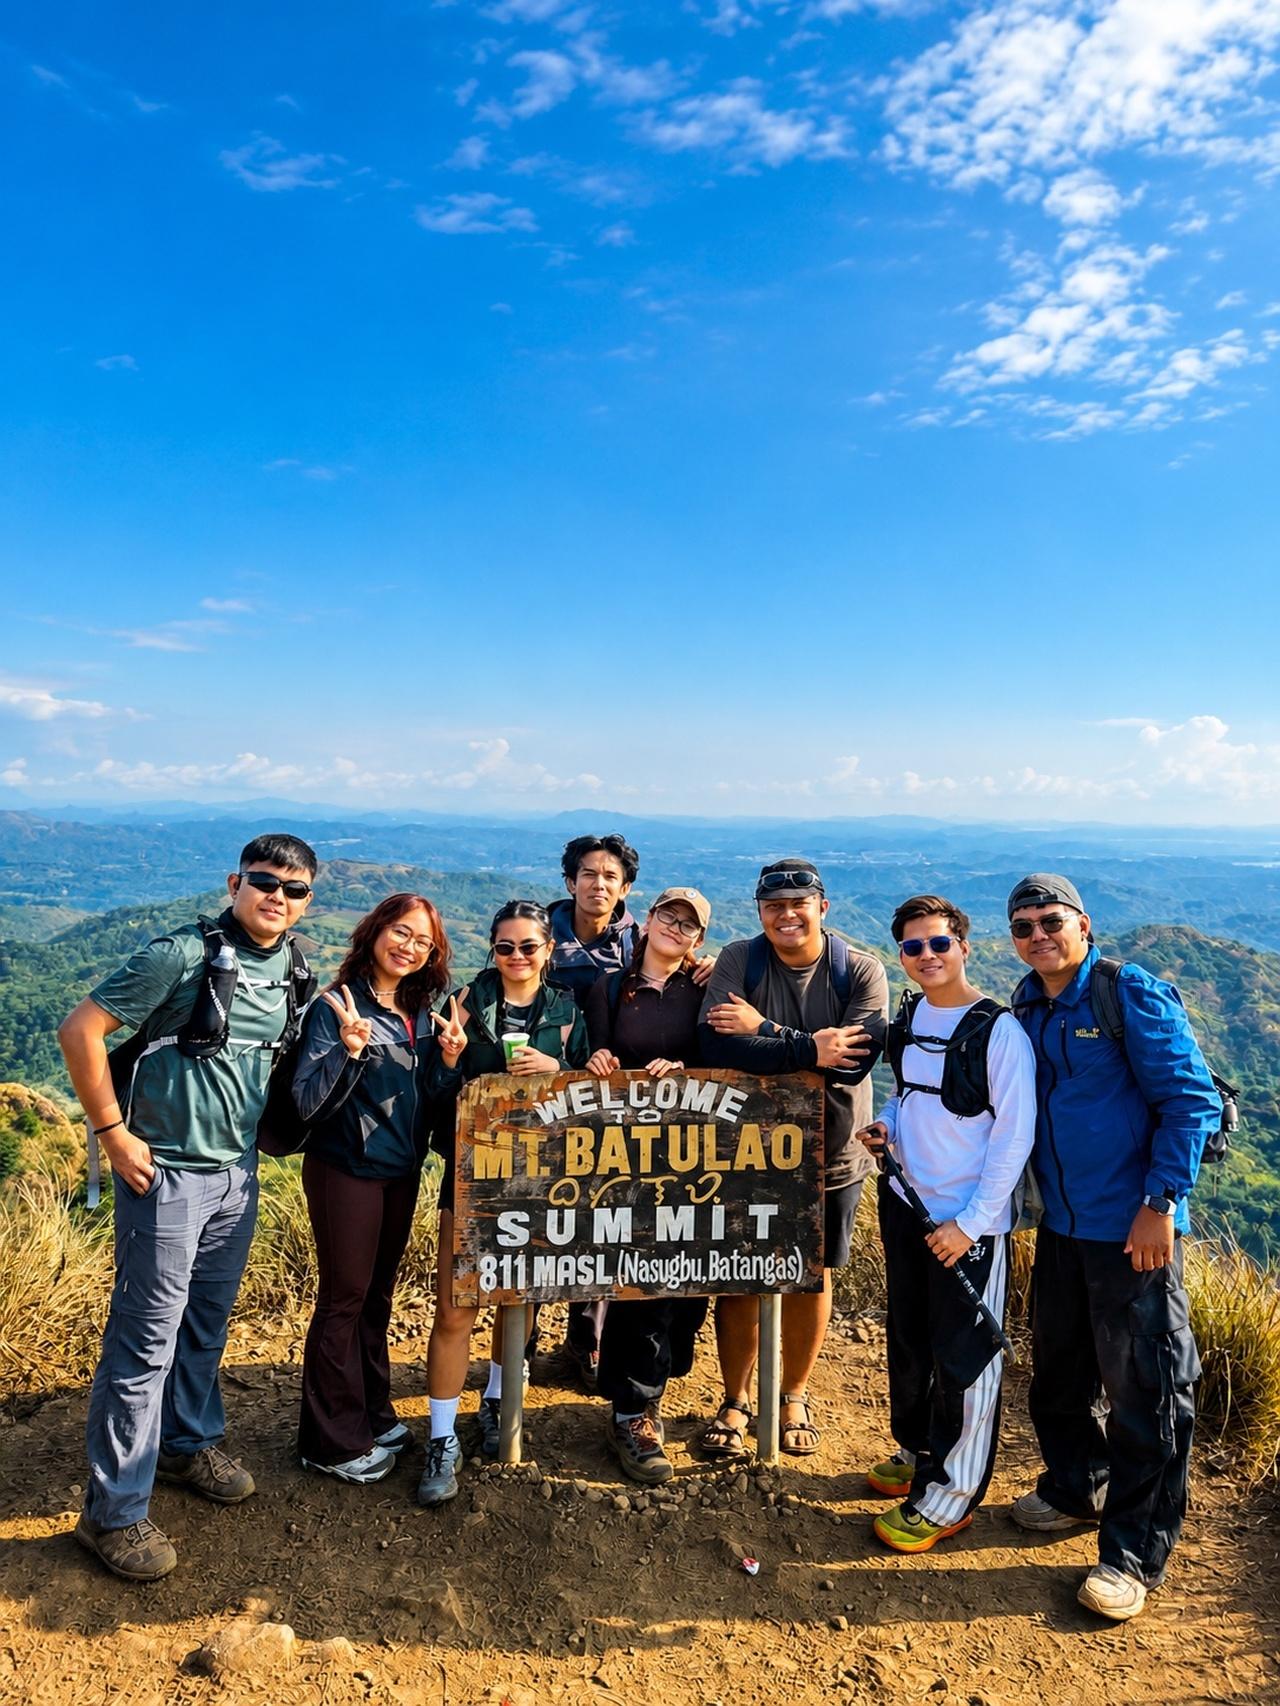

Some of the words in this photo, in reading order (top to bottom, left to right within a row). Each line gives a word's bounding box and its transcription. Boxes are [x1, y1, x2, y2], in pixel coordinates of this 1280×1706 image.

[532, 1077, 749, 1125] WELCOME
[610, 1109, 662, 1124] TO
[473, 1130, 551, 1180] MT.
[565, 1123, 804, 1176] BATULAO
[496, 1203, 779, 1247] SUMMIT
[479, 1253, 527, 1294] 811
[533, 1254, 614, 1288] MASL
